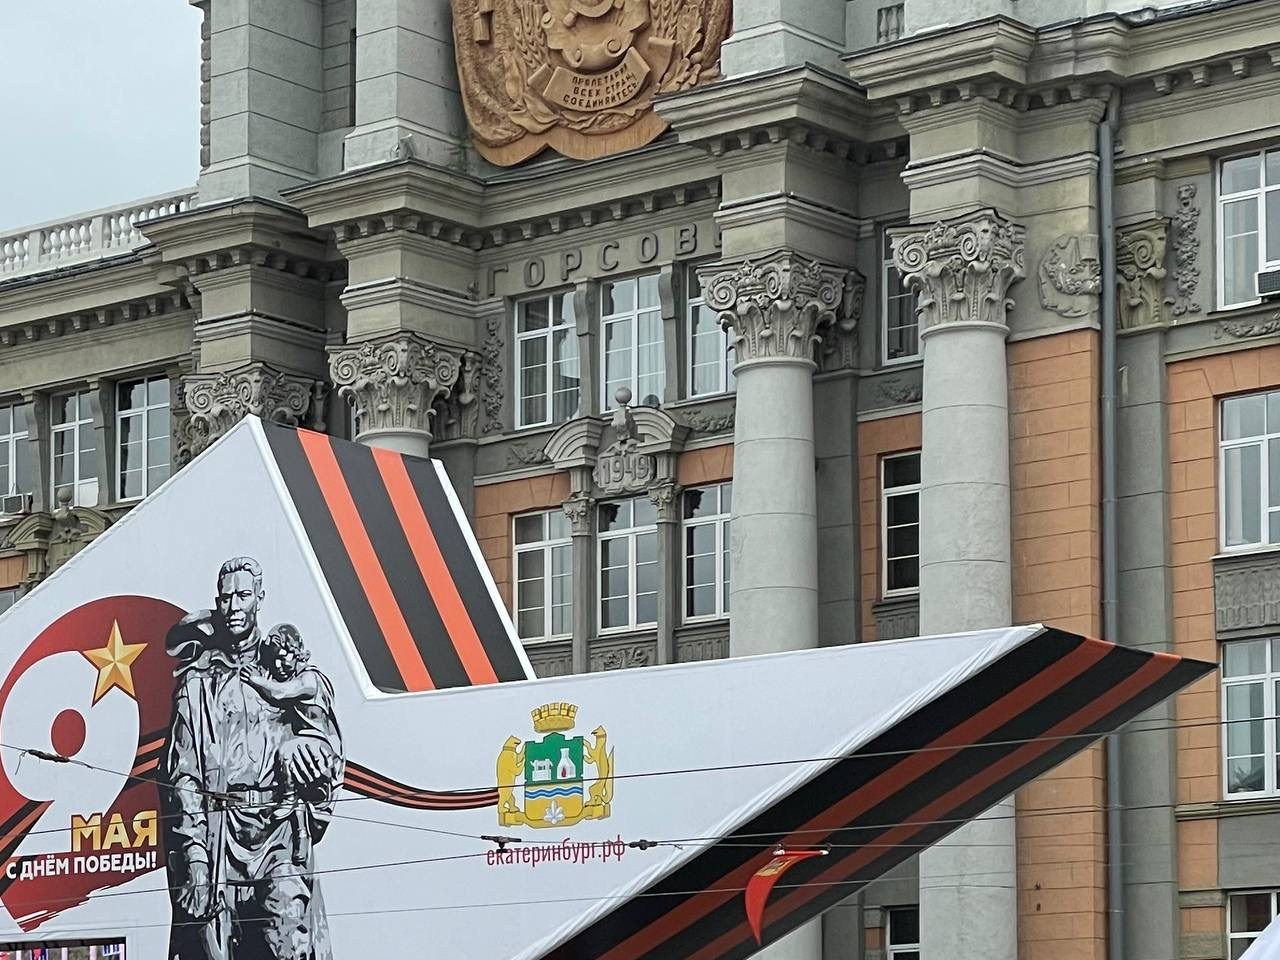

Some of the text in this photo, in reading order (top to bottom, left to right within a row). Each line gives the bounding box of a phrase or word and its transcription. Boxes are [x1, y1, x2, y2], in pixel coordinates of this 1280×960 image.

[573, 87, 601, 98] ВСЕХ
[486, 222, 722, 297] ГОРСОВ
[72, 810, 158, 852] МАЯ
[6, 851, 157, 881] С ДНЁМ ПОБЕДЫ!
[487, 834, 625, 867] екатеринбург.рф
